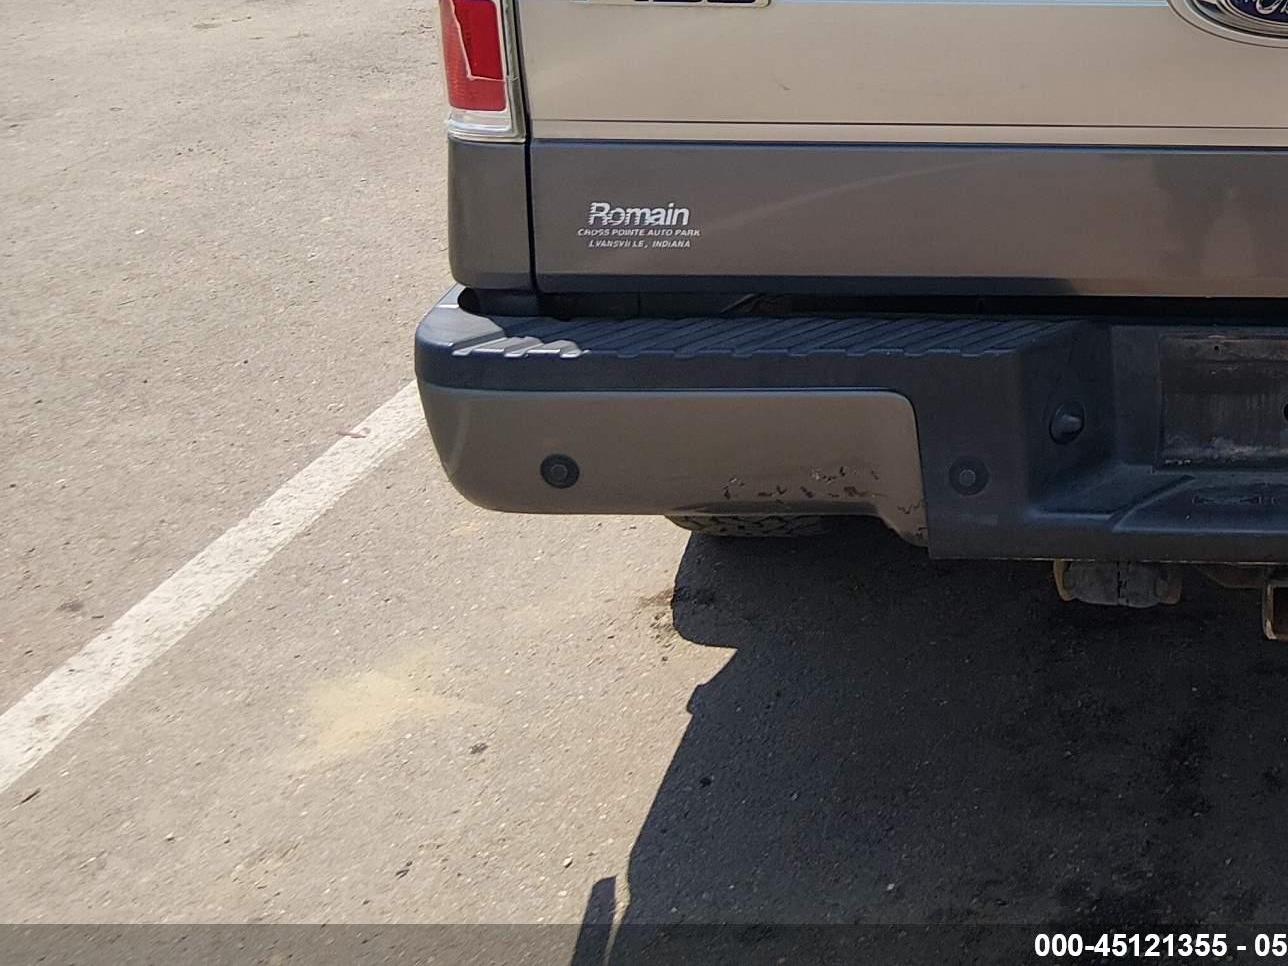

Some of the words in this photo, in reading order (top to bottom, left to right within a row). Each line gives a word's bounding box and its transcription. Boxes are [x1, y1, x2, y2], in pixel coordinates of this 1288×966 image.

[588, 202, 690, 226] Romain
[577, 228, 610, 237] CROSS
[611, 228, 645, 237] POINTE
[647, 228, 673, 237] AUTO
[674, 228, 701, 237] PARK
[652, 240, 691, 248] INDIANA
